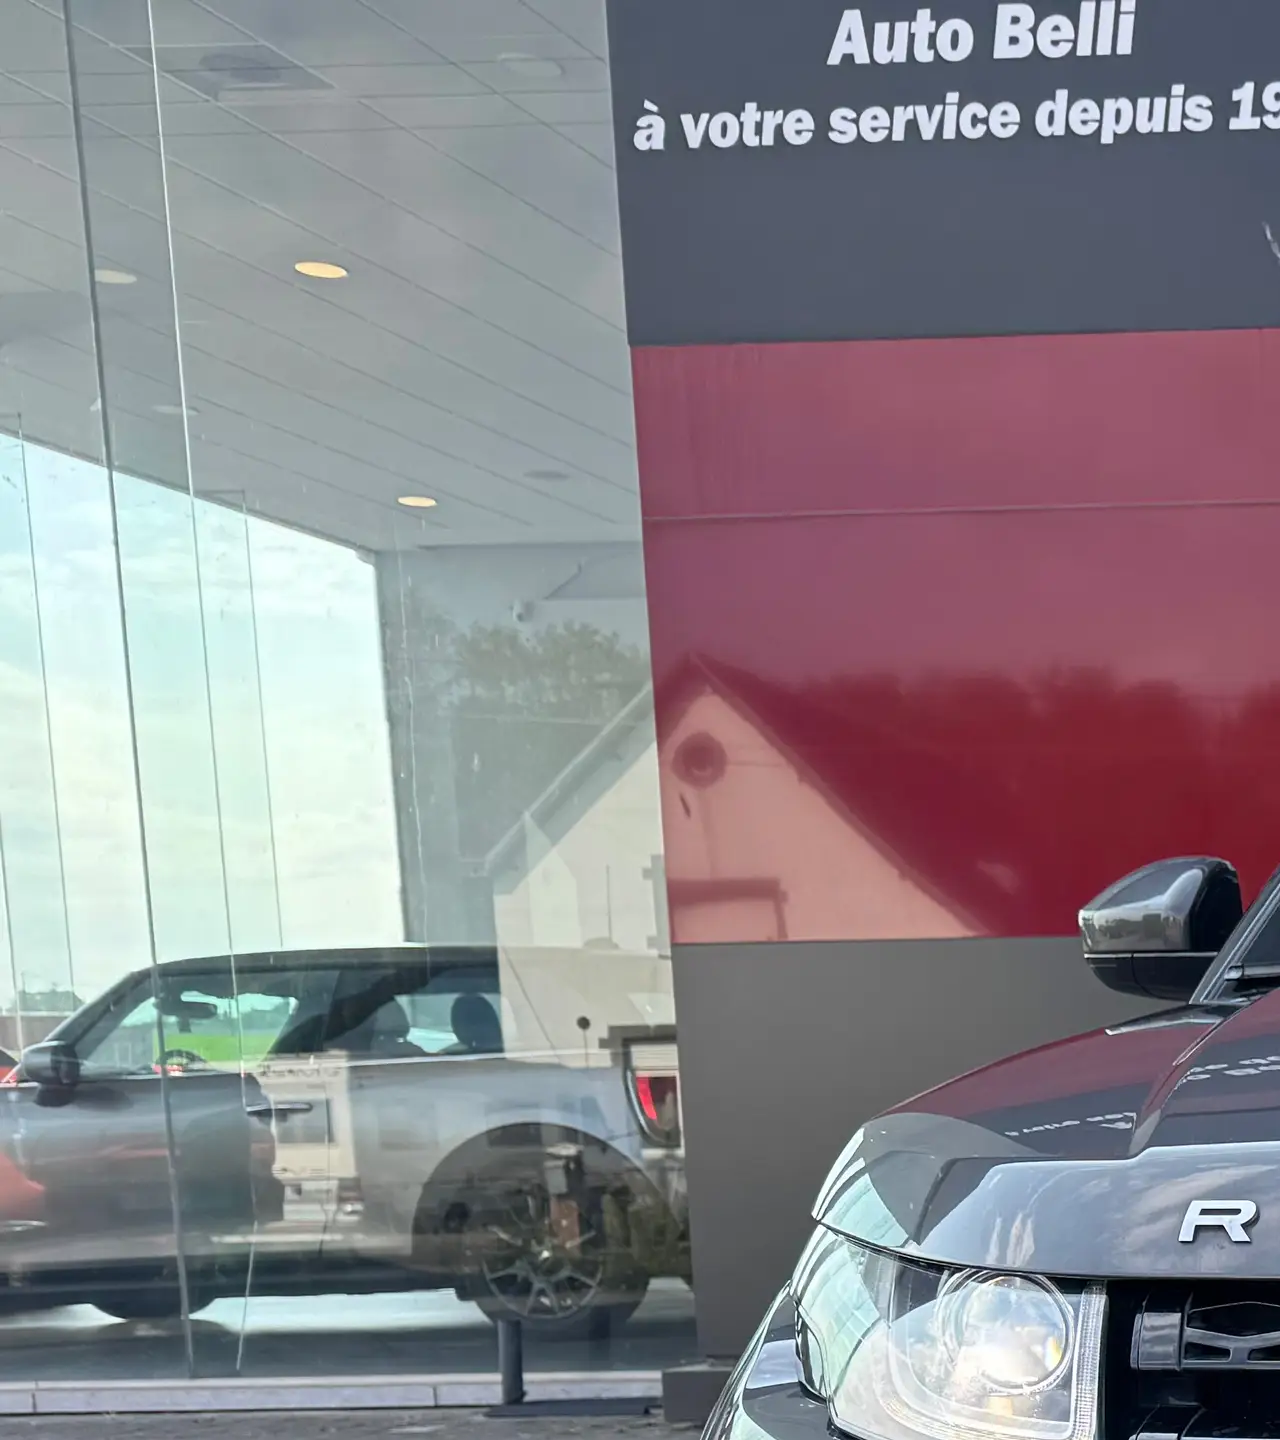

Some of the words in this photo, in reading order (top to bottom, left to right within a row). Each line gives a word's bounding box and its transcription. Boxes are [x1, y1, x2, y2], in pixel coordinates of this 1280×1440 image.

[827, 8, 973, 65] Auto
[994, 0, 1136, 59] Belli
[633, 100, 665, 150] à
[680, 101, 814, 148] votre
[828, 92, 1020, 143] service
[1035, 84, 1213, 144] depuis
